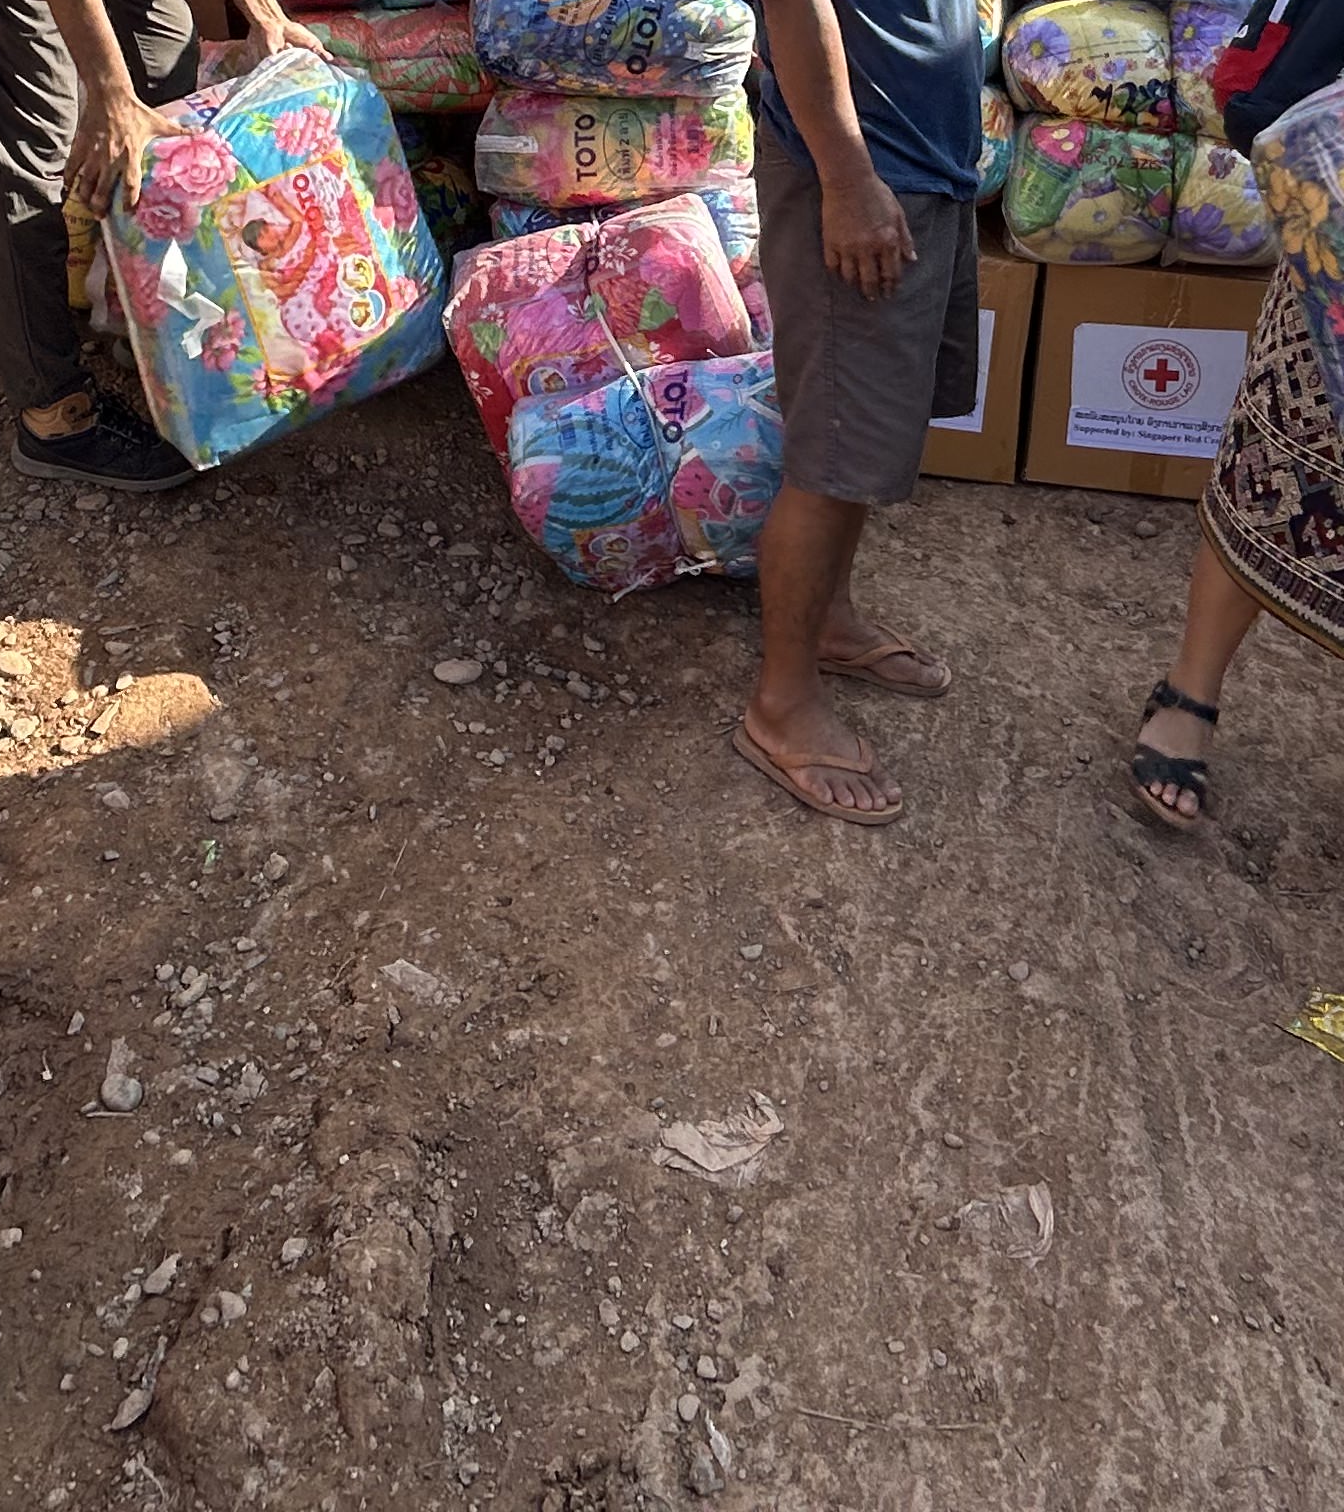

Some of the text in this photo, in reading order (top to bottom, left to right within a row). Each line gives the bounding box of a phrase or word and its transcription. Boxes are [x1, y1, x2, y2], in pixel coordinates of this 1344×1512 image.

[626, 4, 664, 75] TOTO
[575, 114, 597, 182] TOTO
[619, 138, 630, 146] 2
[661, 370, 689, 444] TOTO
[1073, 424, 1119, 437] Supported
[1138, 430, 1182, 443] Singapore
